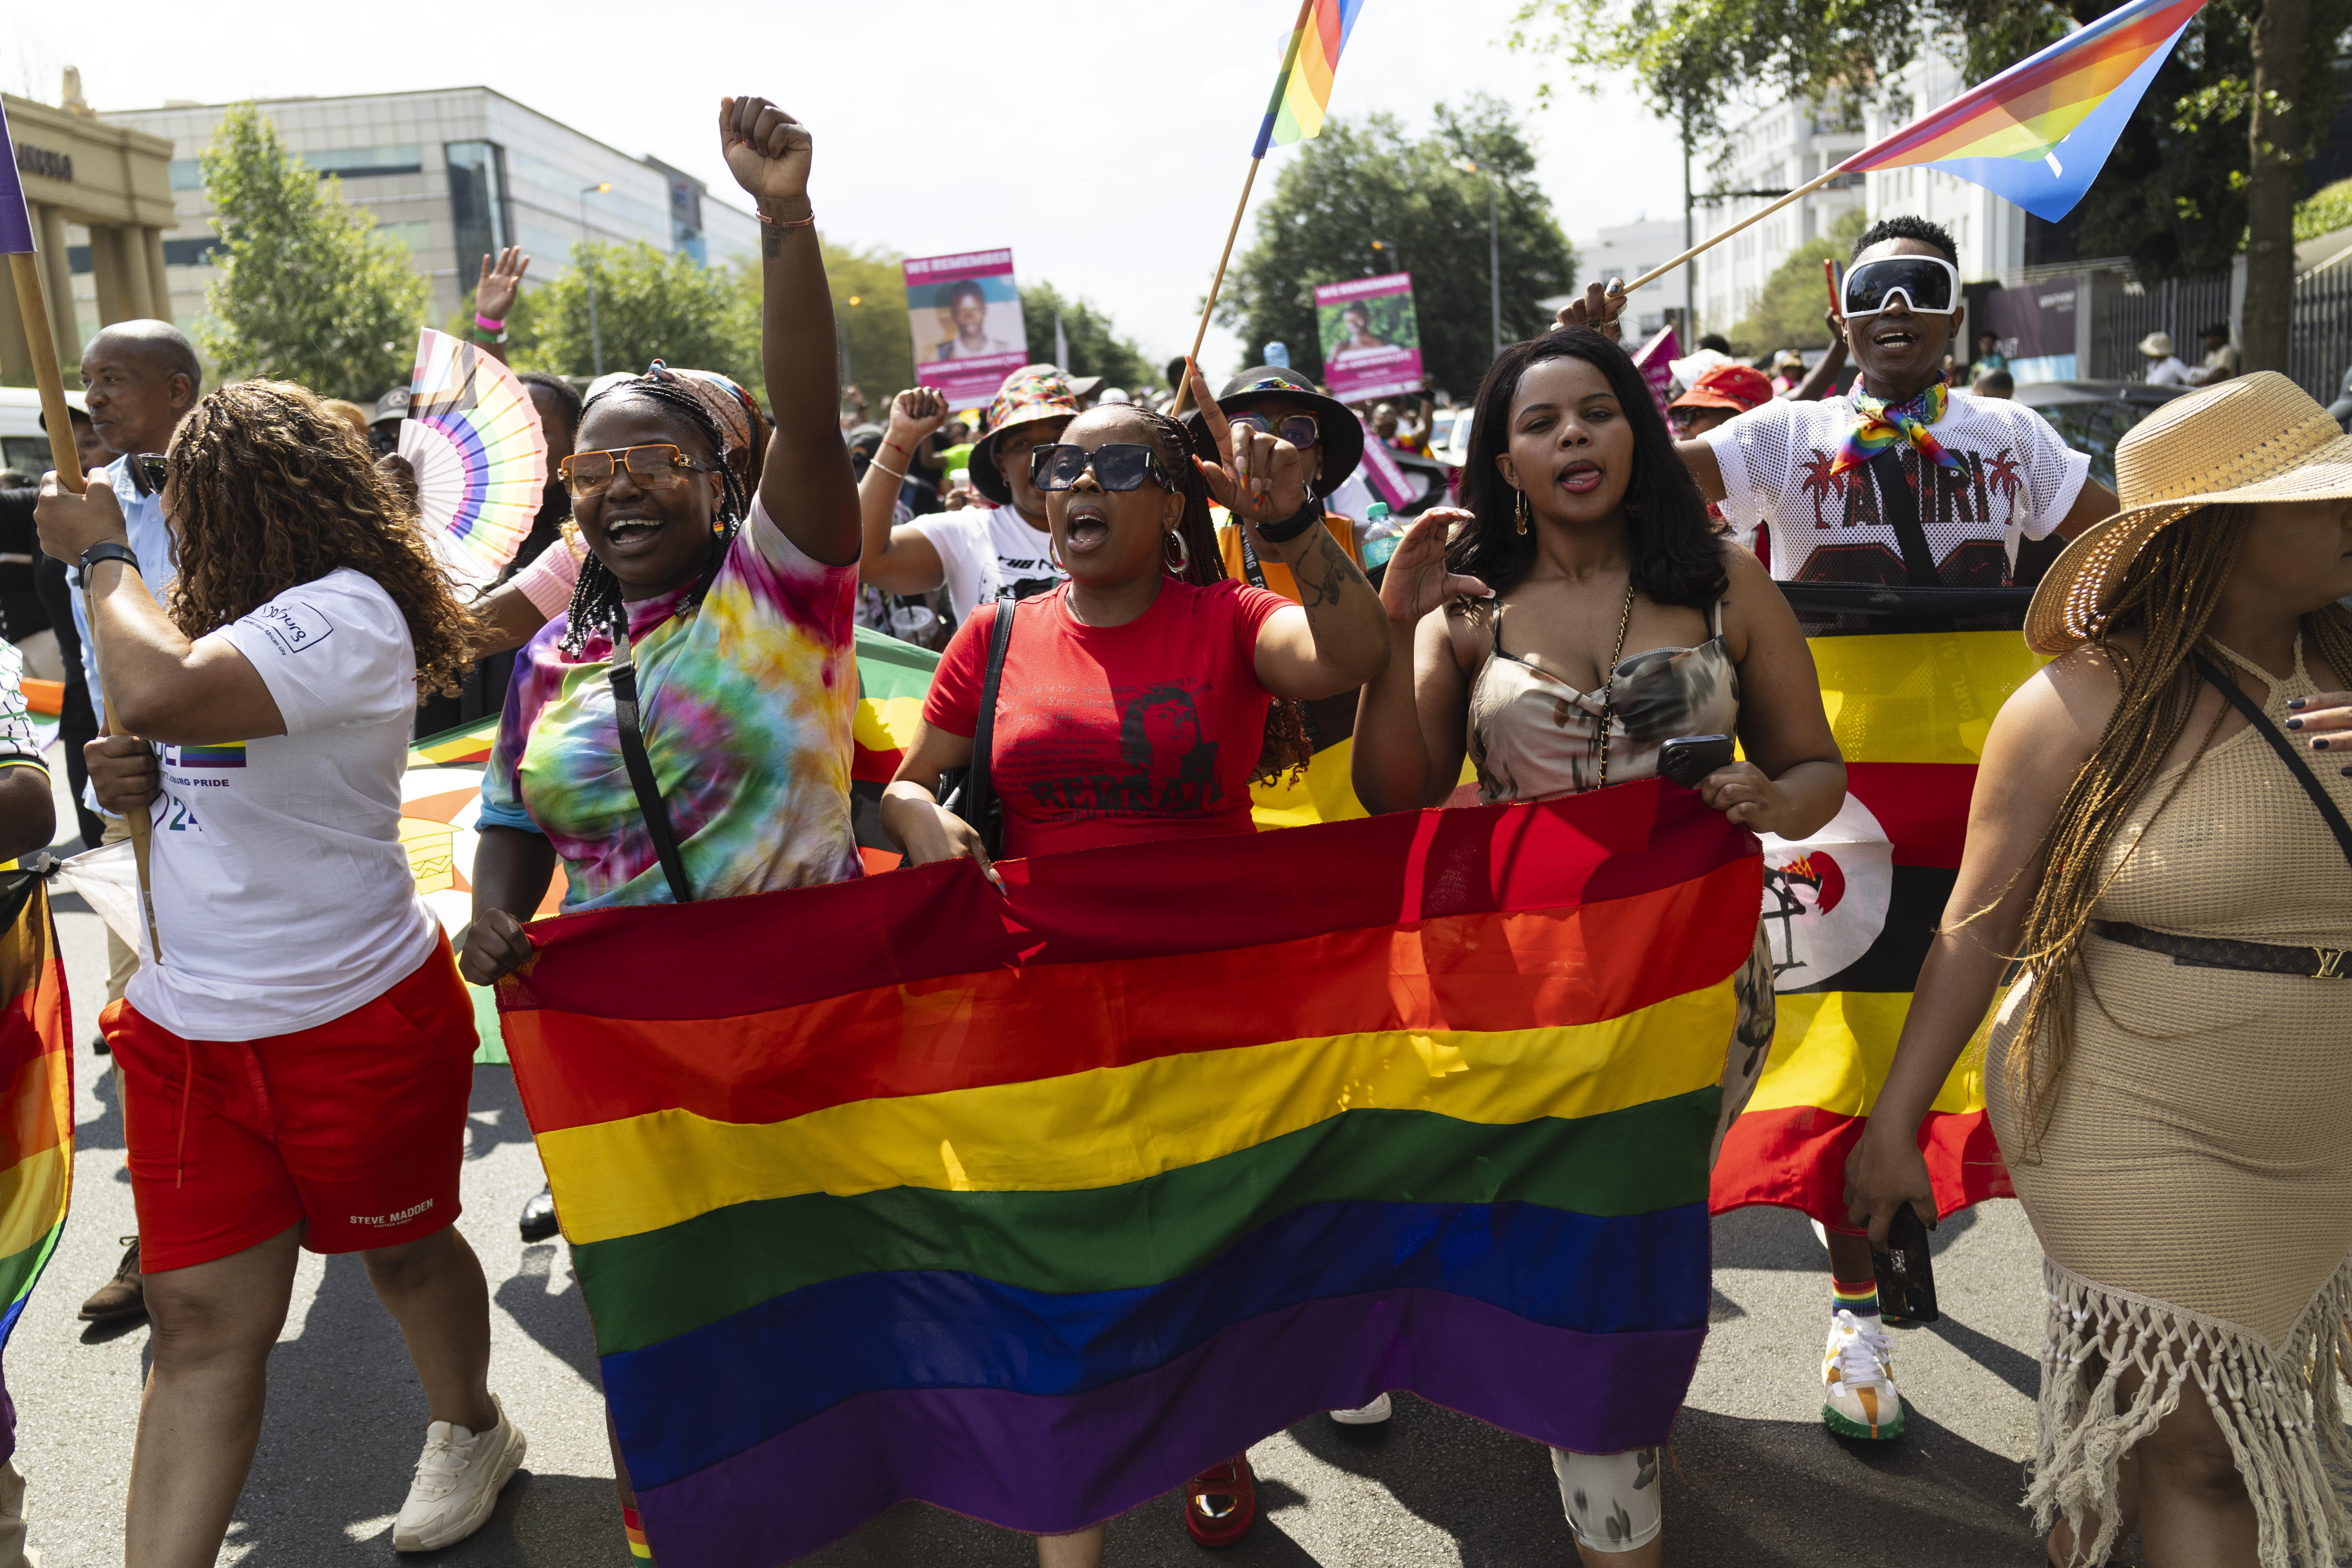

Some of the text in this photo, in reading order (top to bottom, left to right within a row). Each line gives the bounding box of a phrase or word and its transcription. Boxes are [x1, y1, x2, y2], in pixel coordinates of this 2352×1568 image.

[264, 629, 279, 646] African
[278, 645, 287, 656] city
[193, 779, 230, 787] PRIDE
[350, 1198, 434, 1224] STEVE MADDEN
